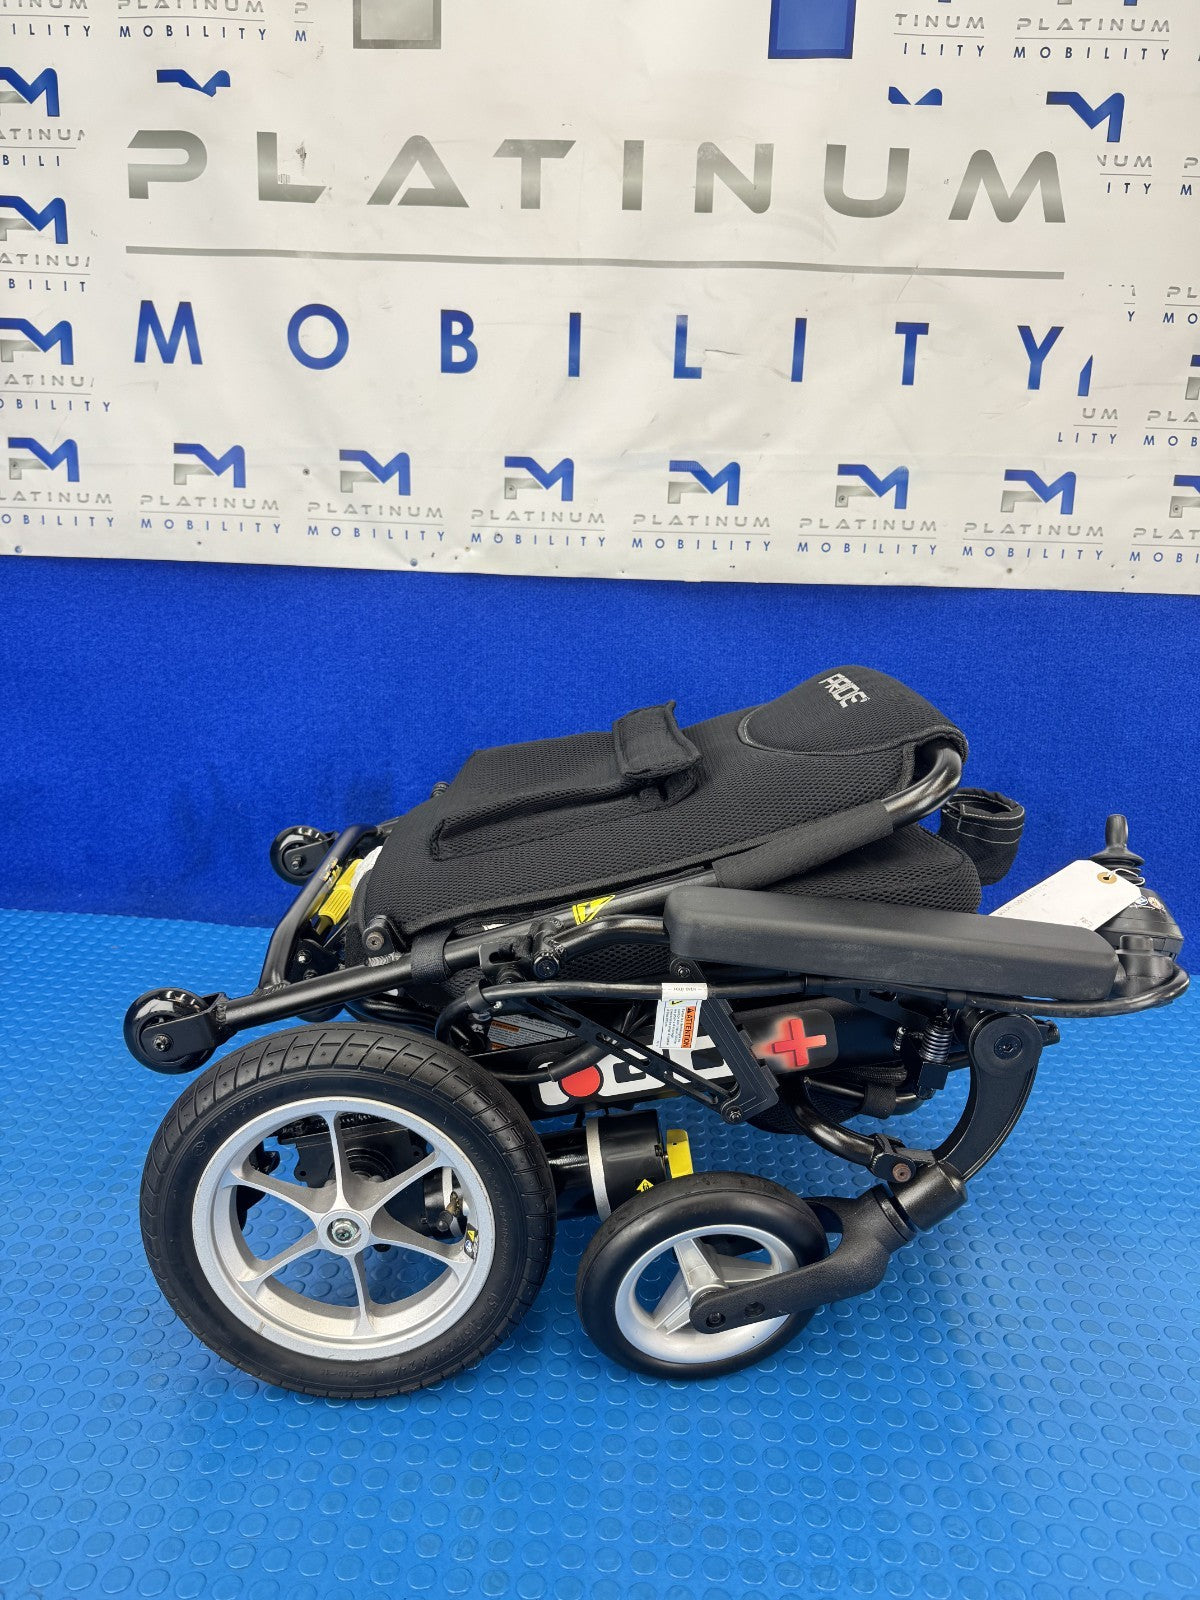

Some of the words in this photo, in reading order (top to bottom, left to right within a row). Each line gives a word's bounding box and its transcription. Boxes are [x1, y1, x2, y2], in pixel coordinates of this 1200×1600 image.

[11, 23, 90, 37] ILITY
[1017, 18, 1169, 32] PLATINUM
[120, 25, 266, 40] MOBILITY
[904, 43, 984, 57] ILITY
[1013, 46, 1169, 61] MOBILITY
[127, 130, 1066, 223] PLATINUM
[8, 278, 85, 292] BILIT
[134, 300, 1064, 390] MOBILITY
[1058, 432, 1117, 444] LITY
[140, 495, 279, 510] PLATINUM
[308, 502, 443, 520] PLATINUM
[471, 509, 604, 523] PLATINUM
[141, 515, 280, 533] MOBILITY
[633, 514, 770, 527] PLATINUM
[800, 518, 936, 531] PLATINUM
[308, 523, 445, 541] MOBILITY
[964, 523, 1103, 537] PLATINUM
[471, 532, 605, 547] MOBILITY
[632, 538, 770, 551] MOBILITY
[797, 542, 936, 555] MOBILITY
[962, 547, 1103, 560] MOBILITY
